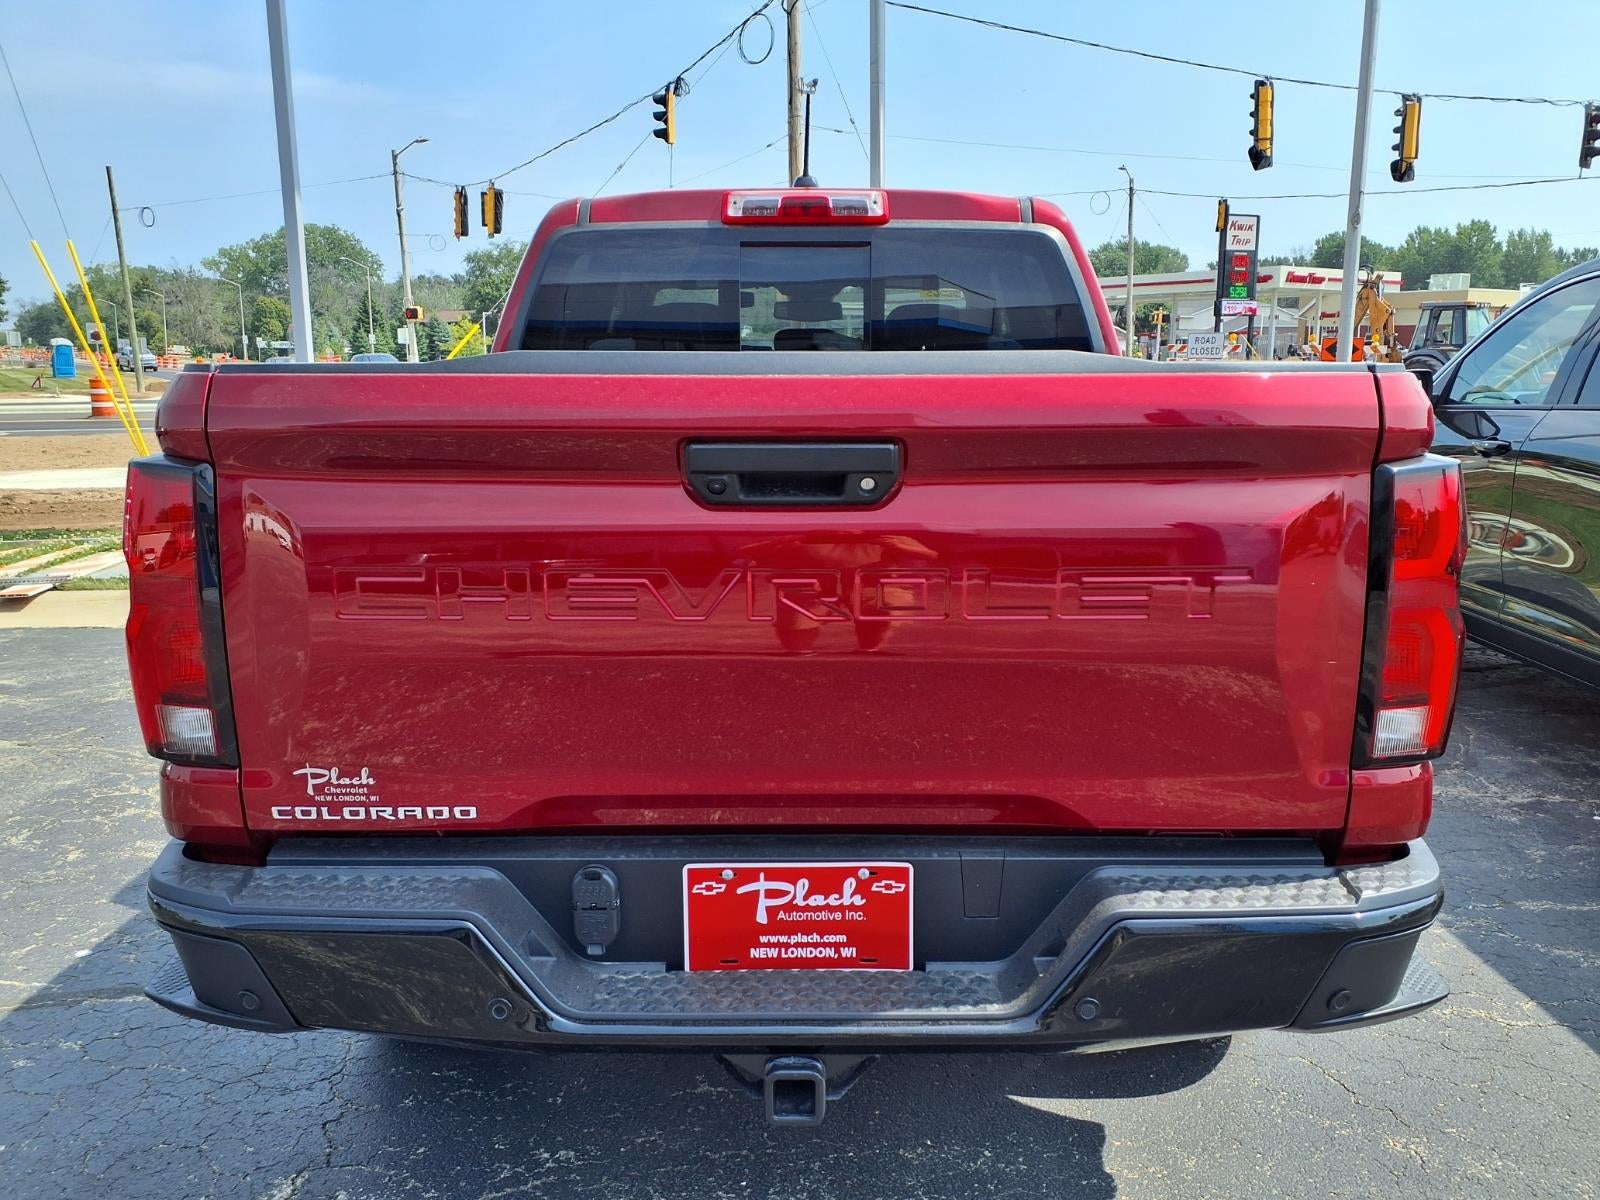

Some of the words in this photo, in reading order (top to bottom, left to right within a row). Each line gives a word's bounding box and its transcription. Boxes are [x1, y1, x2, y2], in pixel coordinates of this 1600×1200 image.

[1229, 220, 1255, 232] KWIK
[1230, 235, 1251, 246] TRIP
[1194, 336, 1217, 345] ROAD
[1190, 346, 1221, 356] CLOSED
[332, 565, 1255, 622] CHEVROLET
[292, 762, 376, 796] Plach
[324, 786, 368, 794] Chevrolet
[333, 795, 369, 803] LONDON,
[271, 806, 478, 820] COLORADO
[736, 871, 867, 925] Plach
[776, 910, 843, 921] Automotive
[845, 910, 867, 921] Inc.
[759, 932, 847, 945] www.plach.com
[750, 947, 779, 958] NEW
[780, 947, 839, 960] LONDON,
[840, 947, 857, 958] WI
